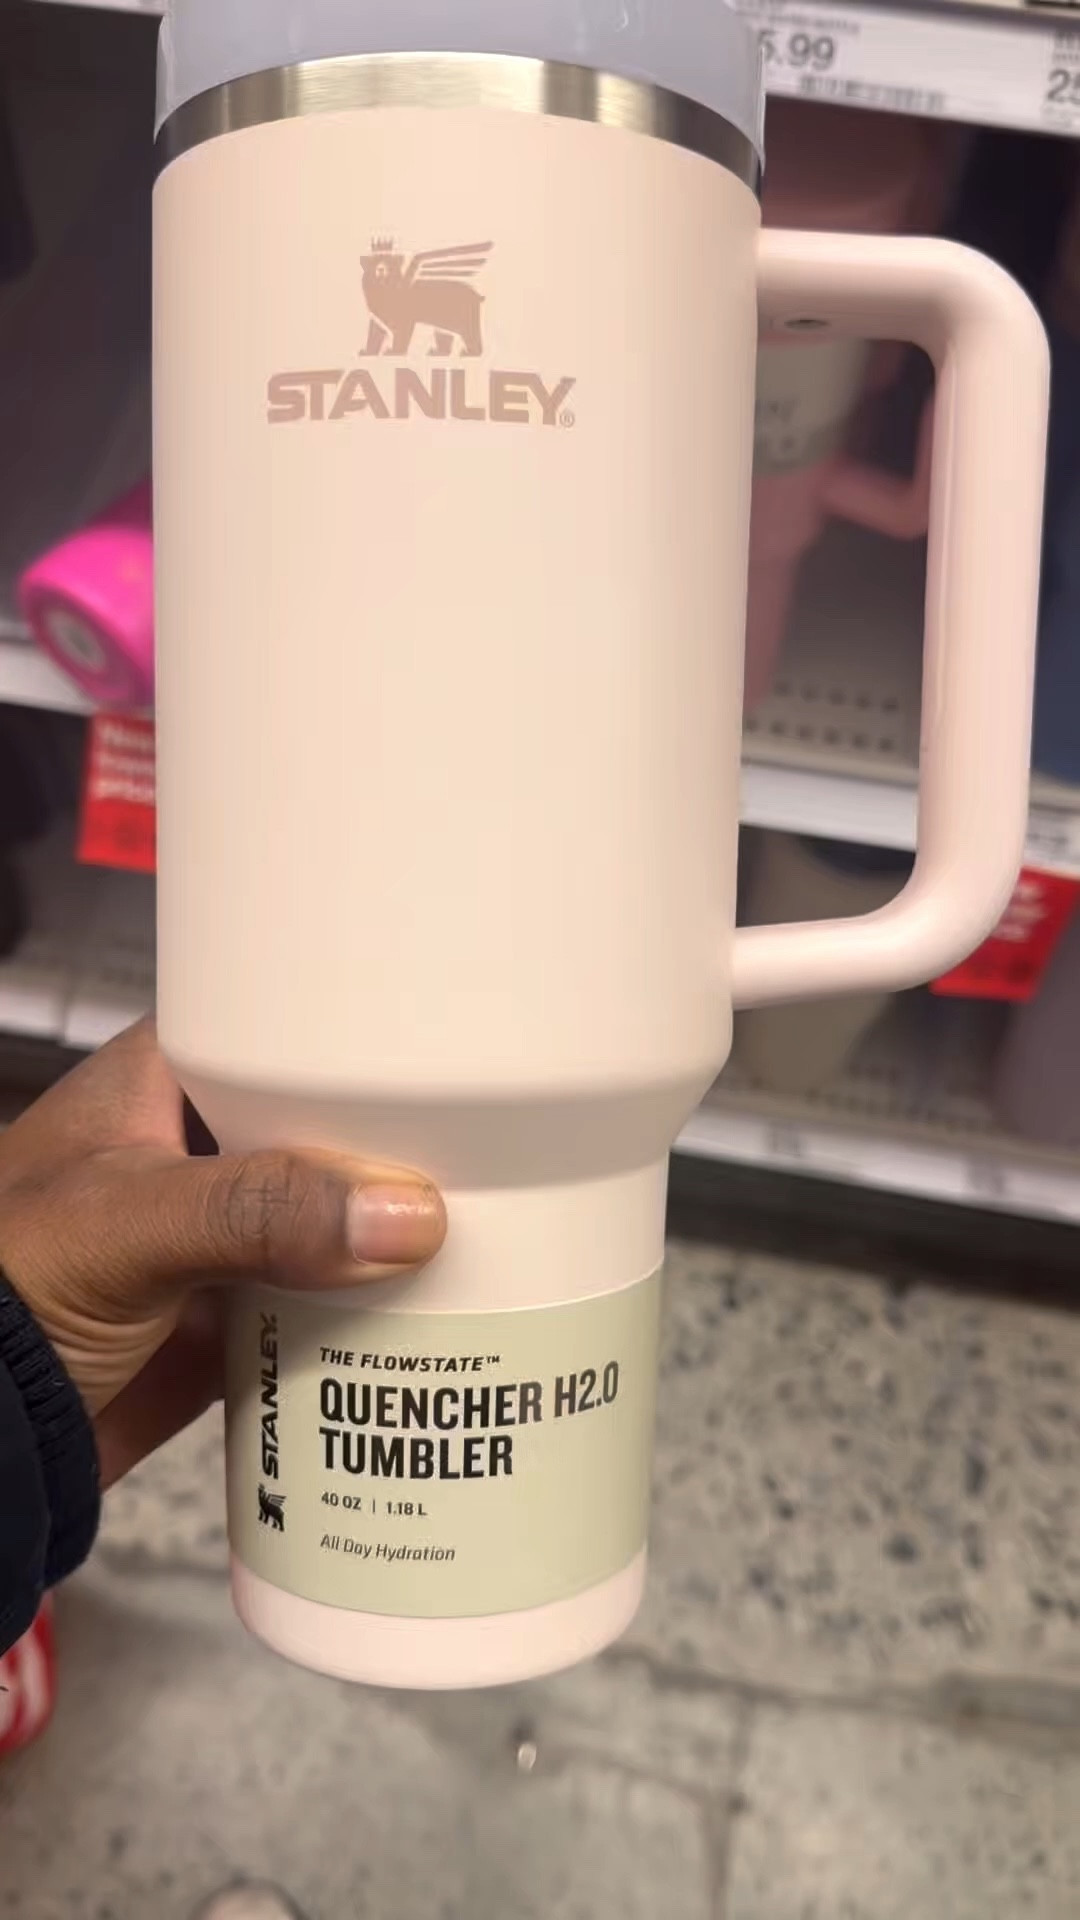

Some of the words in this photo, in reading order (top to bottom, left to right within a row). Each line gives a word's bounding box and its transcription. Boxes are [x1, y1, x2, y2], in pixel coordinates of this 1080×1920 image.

[320, 1347, 354, 1367] THE
[320, 1378, 543, 1430] QUENCHER
[554, 1361, 619, 1418] H2.0
[319, 1427, 513, 1480] TUMBLER
[321, 1492, 338, 1509] 40
[343, 1495, 362, 1511] OZ
[386, 1501, 413, 1516] 1.18
[417, 1503, 428, 1516] L
[320, 1534, 340, 1552] All
[344, 1538, 372, 1558] Day
[376, 1543, 456, 1562] Hydration
